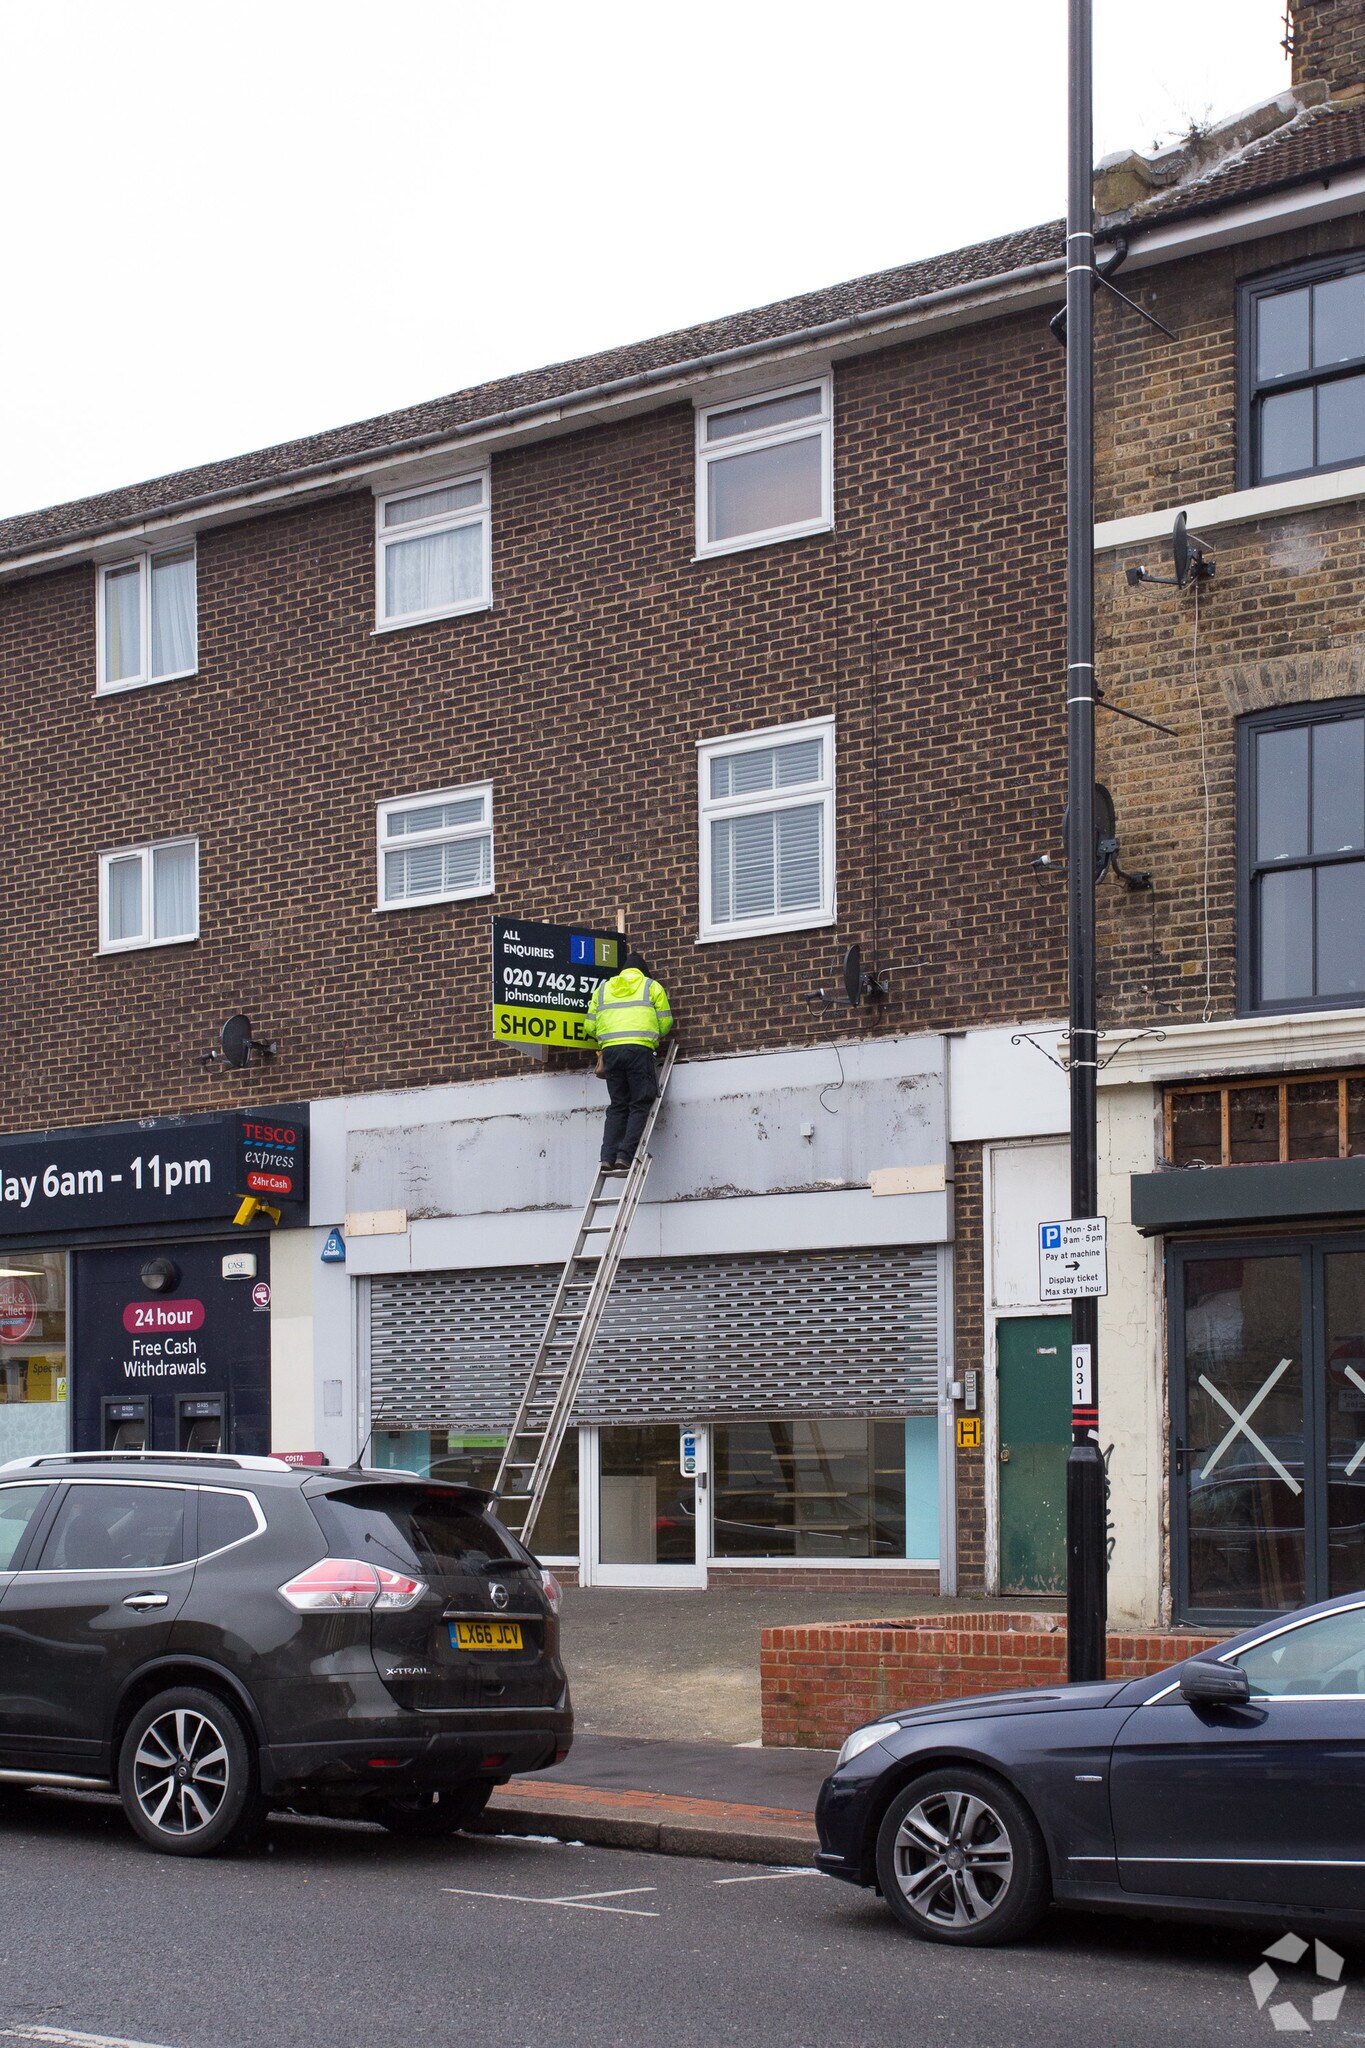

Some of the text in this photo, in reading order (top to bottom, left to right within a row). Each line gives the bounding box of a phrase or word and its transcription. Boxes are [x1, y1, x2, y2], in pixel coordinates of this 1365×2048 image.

[503, 929, 521, 941] ALL
[503, 943, 555, 959] ENQUIRIES
[578, 940, 585, 960] J
[602, 943, 610, 962] F
[503, 967, 533, 987] 020
[536, 971, 576, 992] 7462
[500, 1013, 557, 1039] SHOP
[243, 1123, 296, 1144] TESCO
[245, 1151, 294, 1169] express
[0, 1154, 211, 1208] ay 6am - 11pm
[252, 1176, 288, 1189] 24hr Cash
[1046, 1227, 1058, 1247] P
[1066, 1226, 1082, 1234] Mon
[1087, 1224, 1100, 1232] Sat
[1063, 1236, 1068, 1244] 9
[1085, 1234, 1091, 1242] 5
[1091, 1234, 1103, 1243] pm
[1045, 1249, 1101, 1262] Pay at machine
[227, 1261, 246, 1269] CASE
[1048, 1273, 1098, 1285] Display ticket
[18, 1292, 26, 1304] &
[1045, 1288, 1060, 1296] Max
[1062, 1286, 1078, 1295] stay
[1085, 1285, 1102, 1293] hour
[135, 1307, 193, 1327] 24 hour
[132, 1337, 197, 1356] Free Cash
[123, 1357, 207, 1378] Withdrawals
[960, 1421, 977, 1445] H
[284, 1454, 304, 1462] COSTA
[456, 1623, 519, 1644] LX66 JCV
[385, 1667, 431, 1676] X-TRAIL
